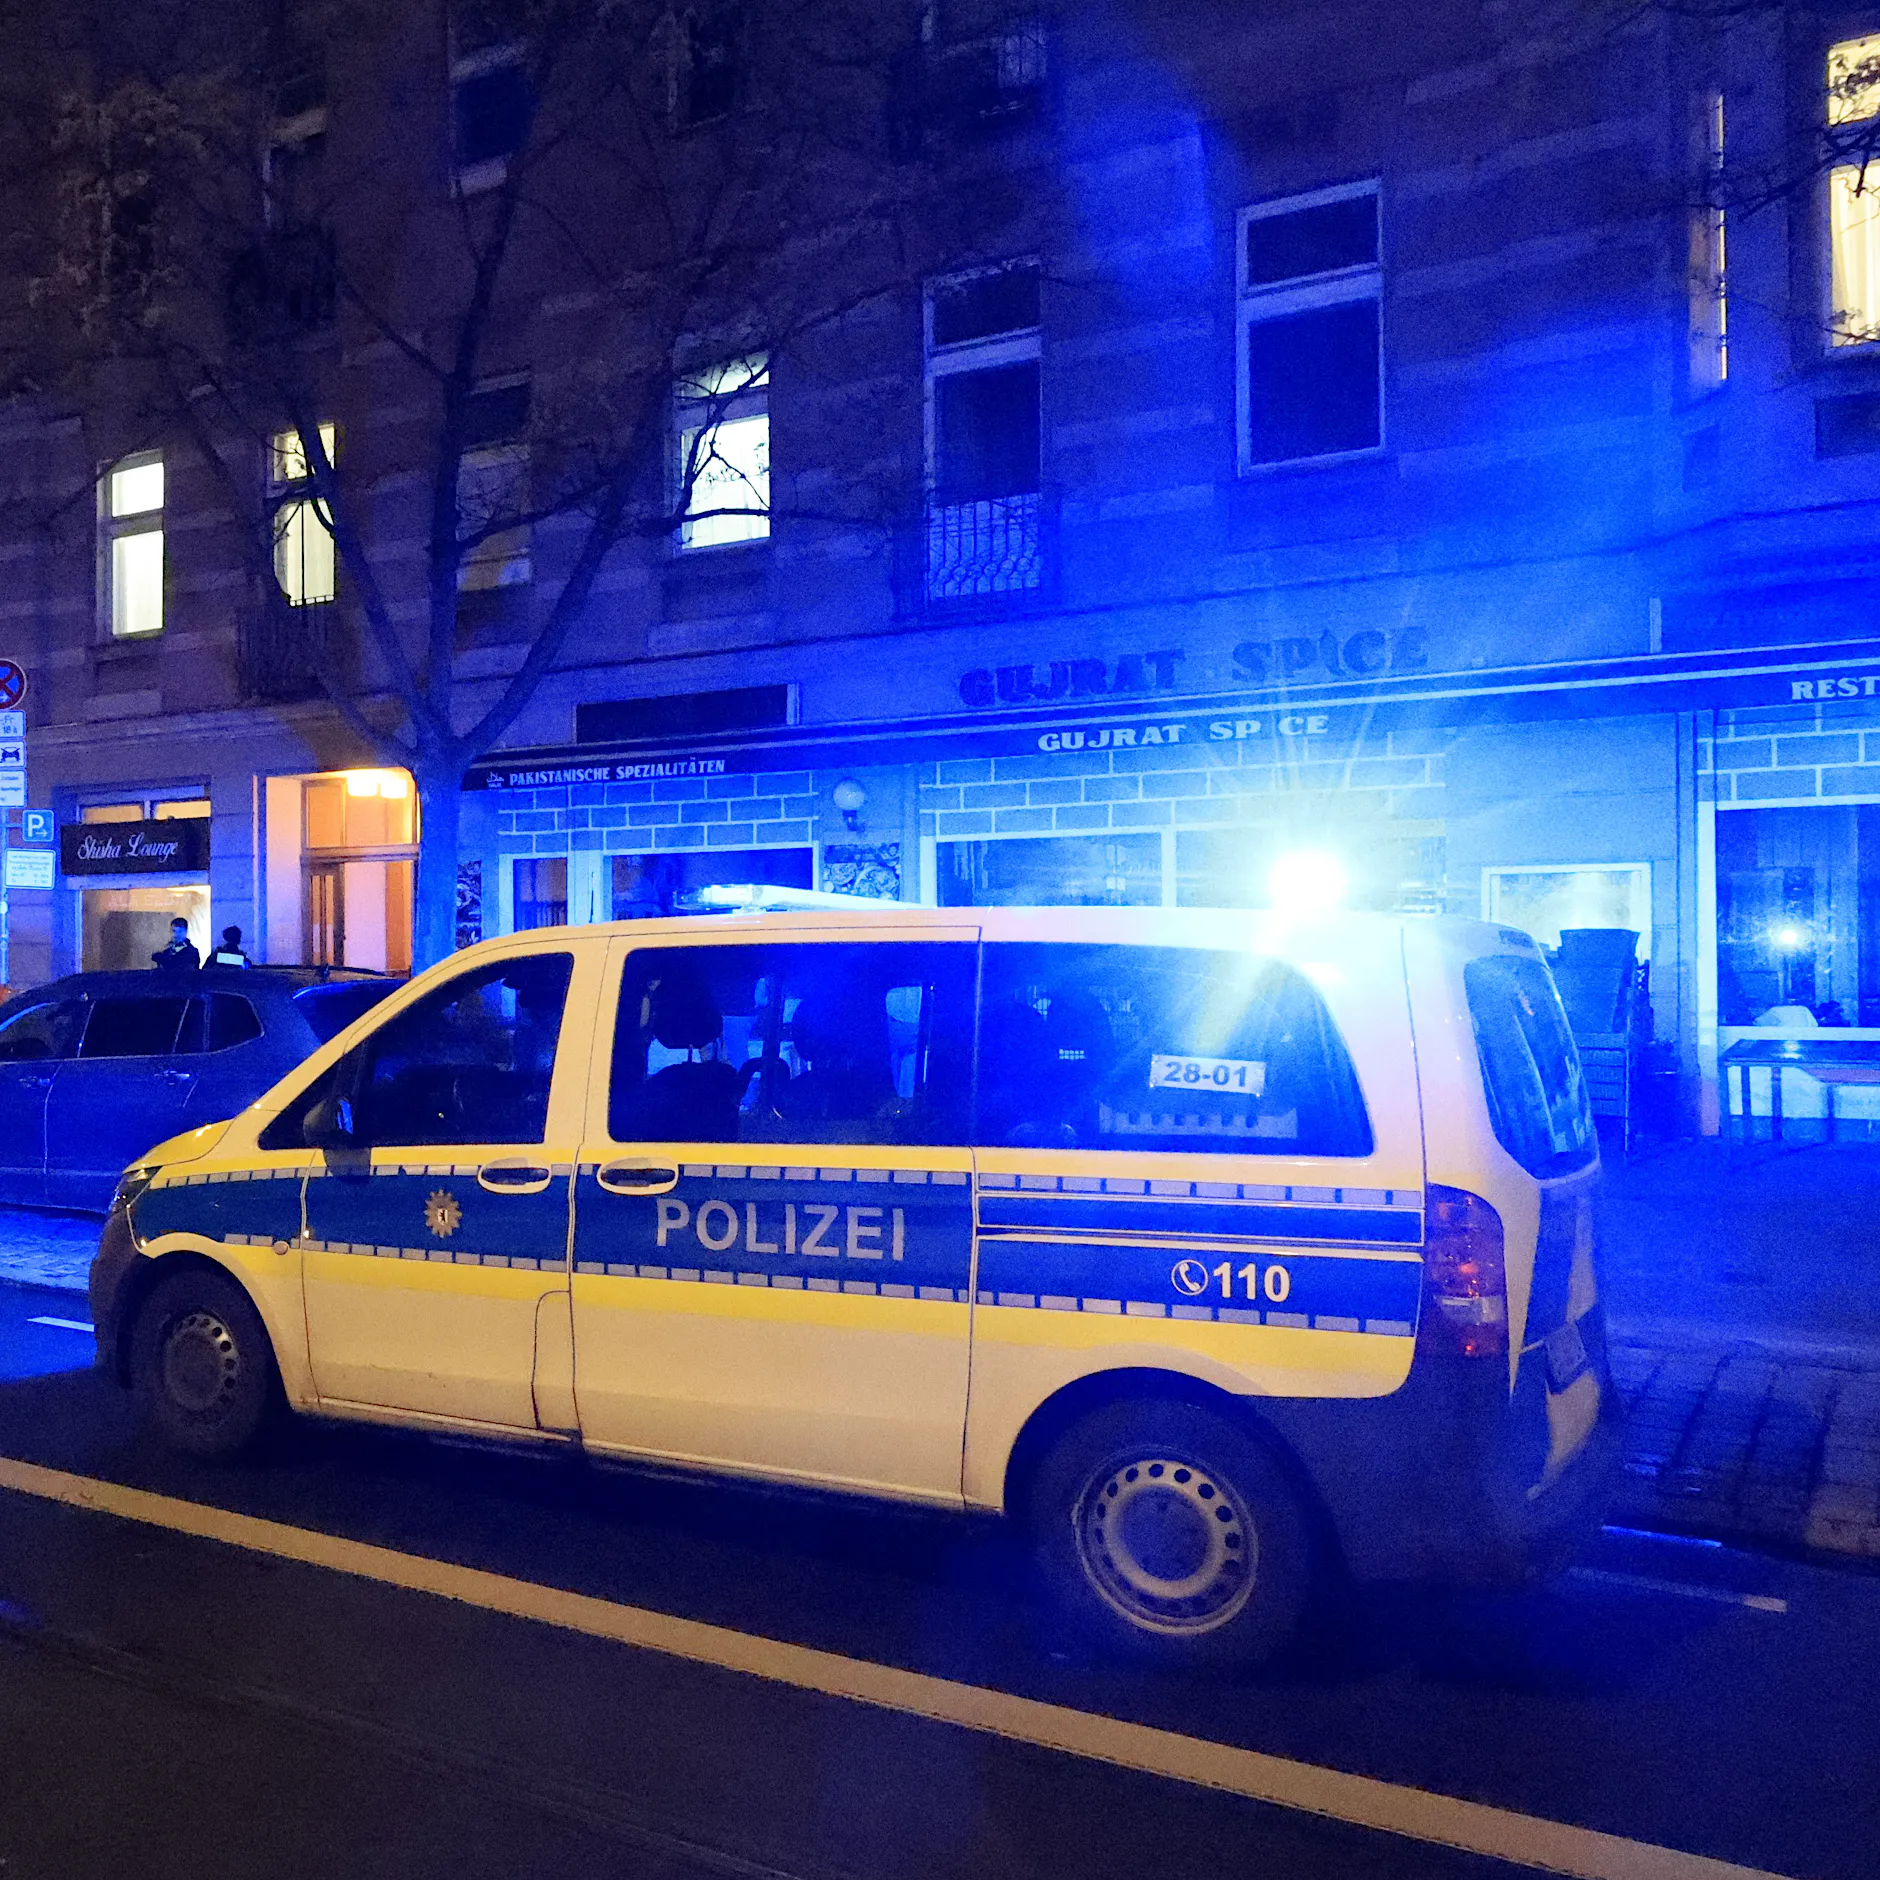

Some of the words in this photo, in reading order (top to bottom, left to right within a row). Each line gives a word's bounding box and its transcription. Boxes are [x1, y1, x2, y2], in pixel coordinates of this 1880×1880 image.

[958, 648, 1187, 706] GUJRAT
[1792, 676, 1880, 700] REST
[1038, 724, 1187, 752] GUJRAT
[1209, 715, 1329, 741] SPCE
[510, 766, 611, 786] PAKISTANISCHE
[616, 757, 726, 780] SPEZIALITÄTEN
[27, 814, 45, 837] P
[77, 835, 121, 860] Shisha
[126, 832, 179, 863] Lounge
[1163, 1061, 1248, 1088] 28-01
[655, 1198, 904, 1261] POLIZEI
[1213, 1262, 1291, 1302] 110
